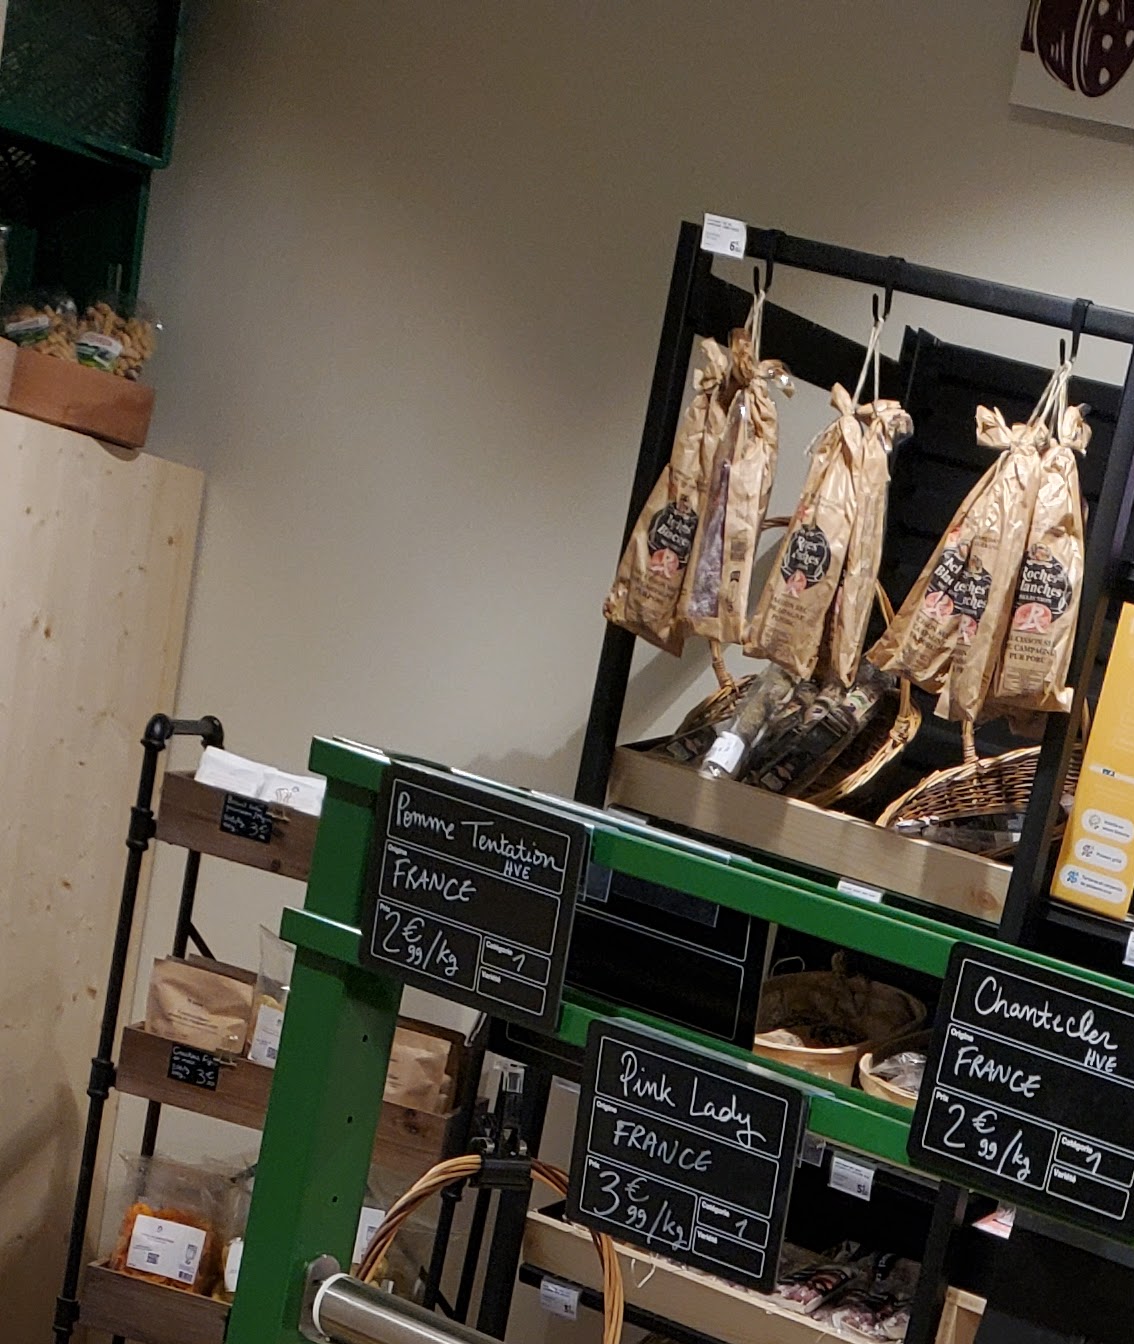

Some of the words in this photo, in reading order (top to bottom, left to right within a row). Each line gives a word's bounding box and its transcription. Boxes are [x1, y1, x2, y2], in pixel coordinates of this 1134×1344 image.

[1020, 582, 1062, 598] lanches
[1014, 645, 1054, 656] CAMPAGN
[397, 792, 454, 839] Pomme
[461, 820, 565, 872] Tentation
[393, 858, 477, 902] FRANCE
[504, 861, 530, 880] HVE
[513, 954, 525, 972] 1
[974, 976, 1118, 1050] Chantecler
[951, 1027, 974, 1043] Origine
[1084, 1049, 1117, 1073] HVE
[954, 1046, 1041, 1098] FRANCE
[620, 1051, 675, 1107] Pink
[690, 1076, 767, 1148] Lady
[936, 1091, 949, 1103] Prix
[613, 1120, 712, 1172] FRANCE
[1061, 1136, 1093, 1154] Catégorie
[588, 1159, 600, 1169] Prix
[1086, 1152, 1101, 1174] 1
[1053, 1168, 1077, 1184] Variété
[735, 1219, 748, 1238] 1
